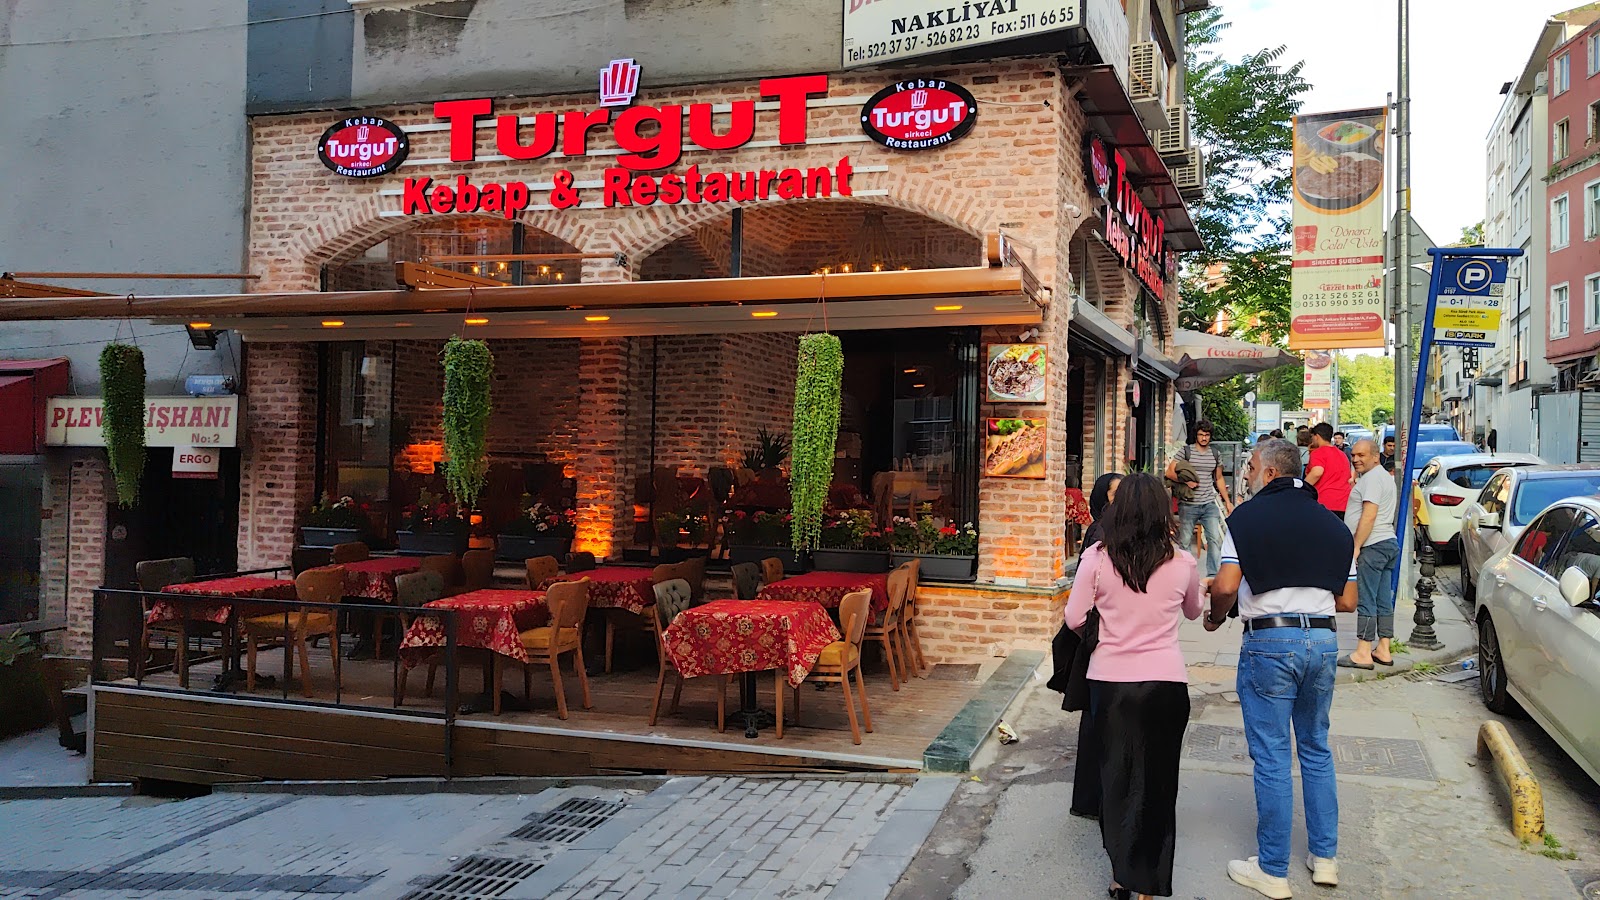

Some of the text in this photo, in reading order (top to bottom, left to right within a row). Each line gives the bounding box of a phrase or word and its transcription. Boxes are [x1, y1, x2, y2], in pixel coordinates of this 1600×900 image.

[891, 0, 1018, 35] NAKLİYAT
[848, 46, 865, 61] Tel:
[867, 42, 886, 58] 522
[889, 39, 902, 54] 37
[905, 36, 918, 51] 37
[926, 31, 947, 47] 526
[949, 27, 963, 43] 82
[966, 24, 980, 40] 23
[991, 20, 1017, 35] Fax:
[1020, 14, 1036, 30] 511
[1040, 10, 1056, 26] 66
[1059, 6, 1074, 23] 55
[895, 79, 946, 92] Kebap
[345, 116, 384, 127] Kebap
[433, 75, 829, 170] TurguT
[872, 101, 965, 130] TurguT
[886, 132, 952, 149] Restaurant
[904, 130, 932, 138] sirkeci
[327, 137, 397, 161] TurguT
[336, 163, 386, 176] Restaurant
[403, 156, 853, 219] Kebap & Restaurant
[1338, 256, 1363, 266] ŞUBESİ
[1465, 268, 1486, 284] P
[1330, 299, 1348, 307] 990
[179, 454, 212, 464] ERGO
